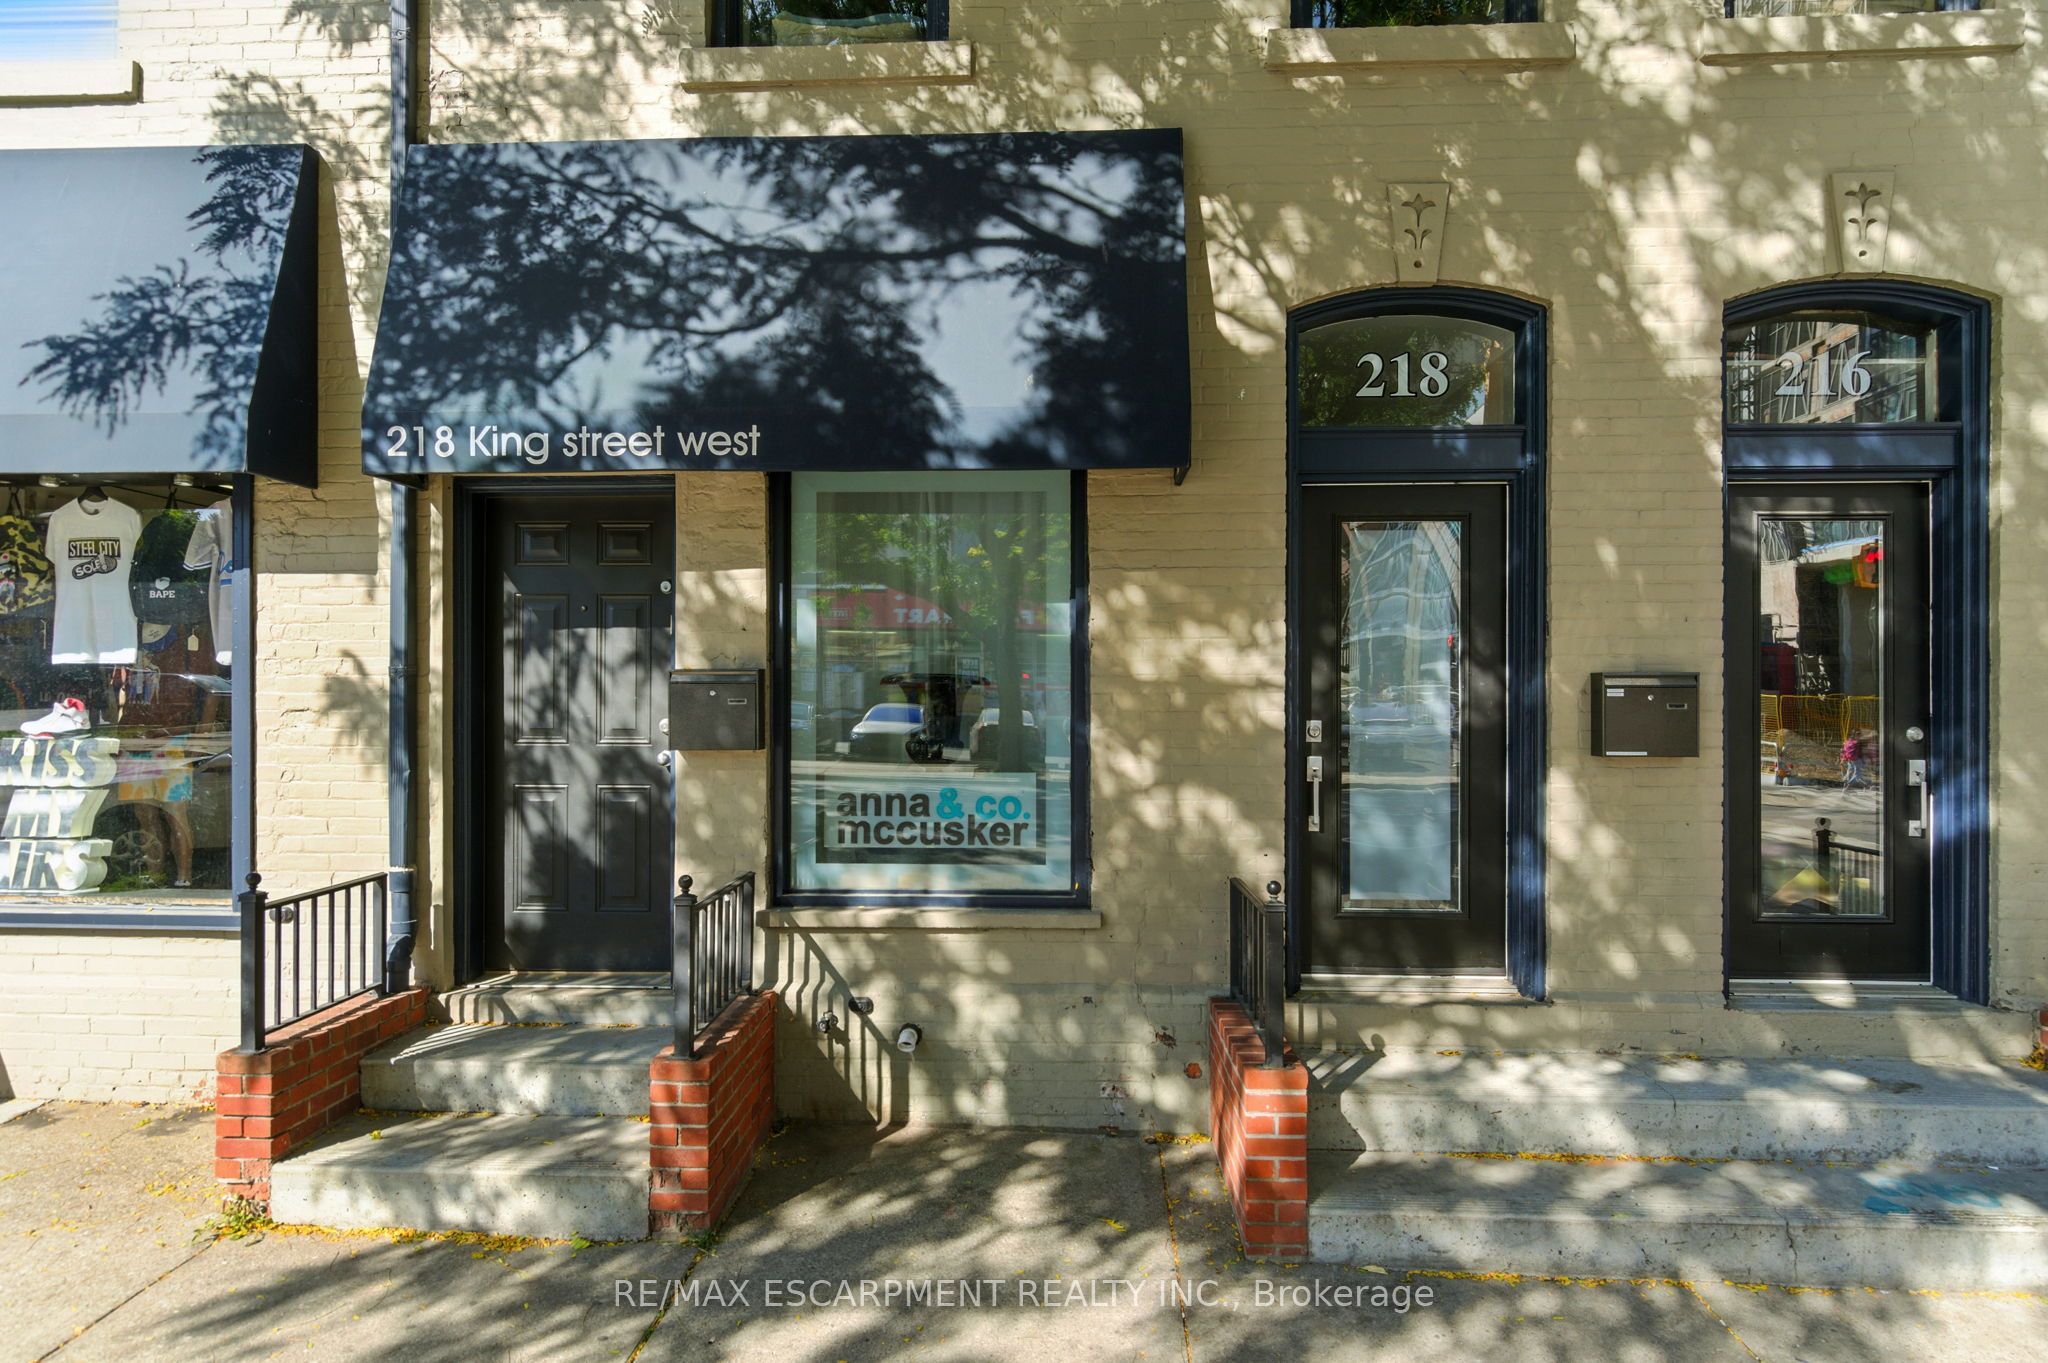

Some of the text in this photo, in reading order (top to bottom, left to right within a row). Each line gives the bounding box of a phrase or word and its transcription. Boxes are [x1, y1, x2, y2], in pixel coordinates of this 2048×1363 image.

[1355, 351, 1450, 398] 218
[1775, 350, 1873, 397] 216
[386, 424, 761, 465] 218 King street west
[69, 540, 119, 557] STEEL CITY
[149, 590, 176, 599] BAPE
[0, 736, 114, 788] KISS
[0, 788, 104, 838] MY
[836, 787, 1031, 820] anna & co.
[836, 814, 1029, 847] mccusker
